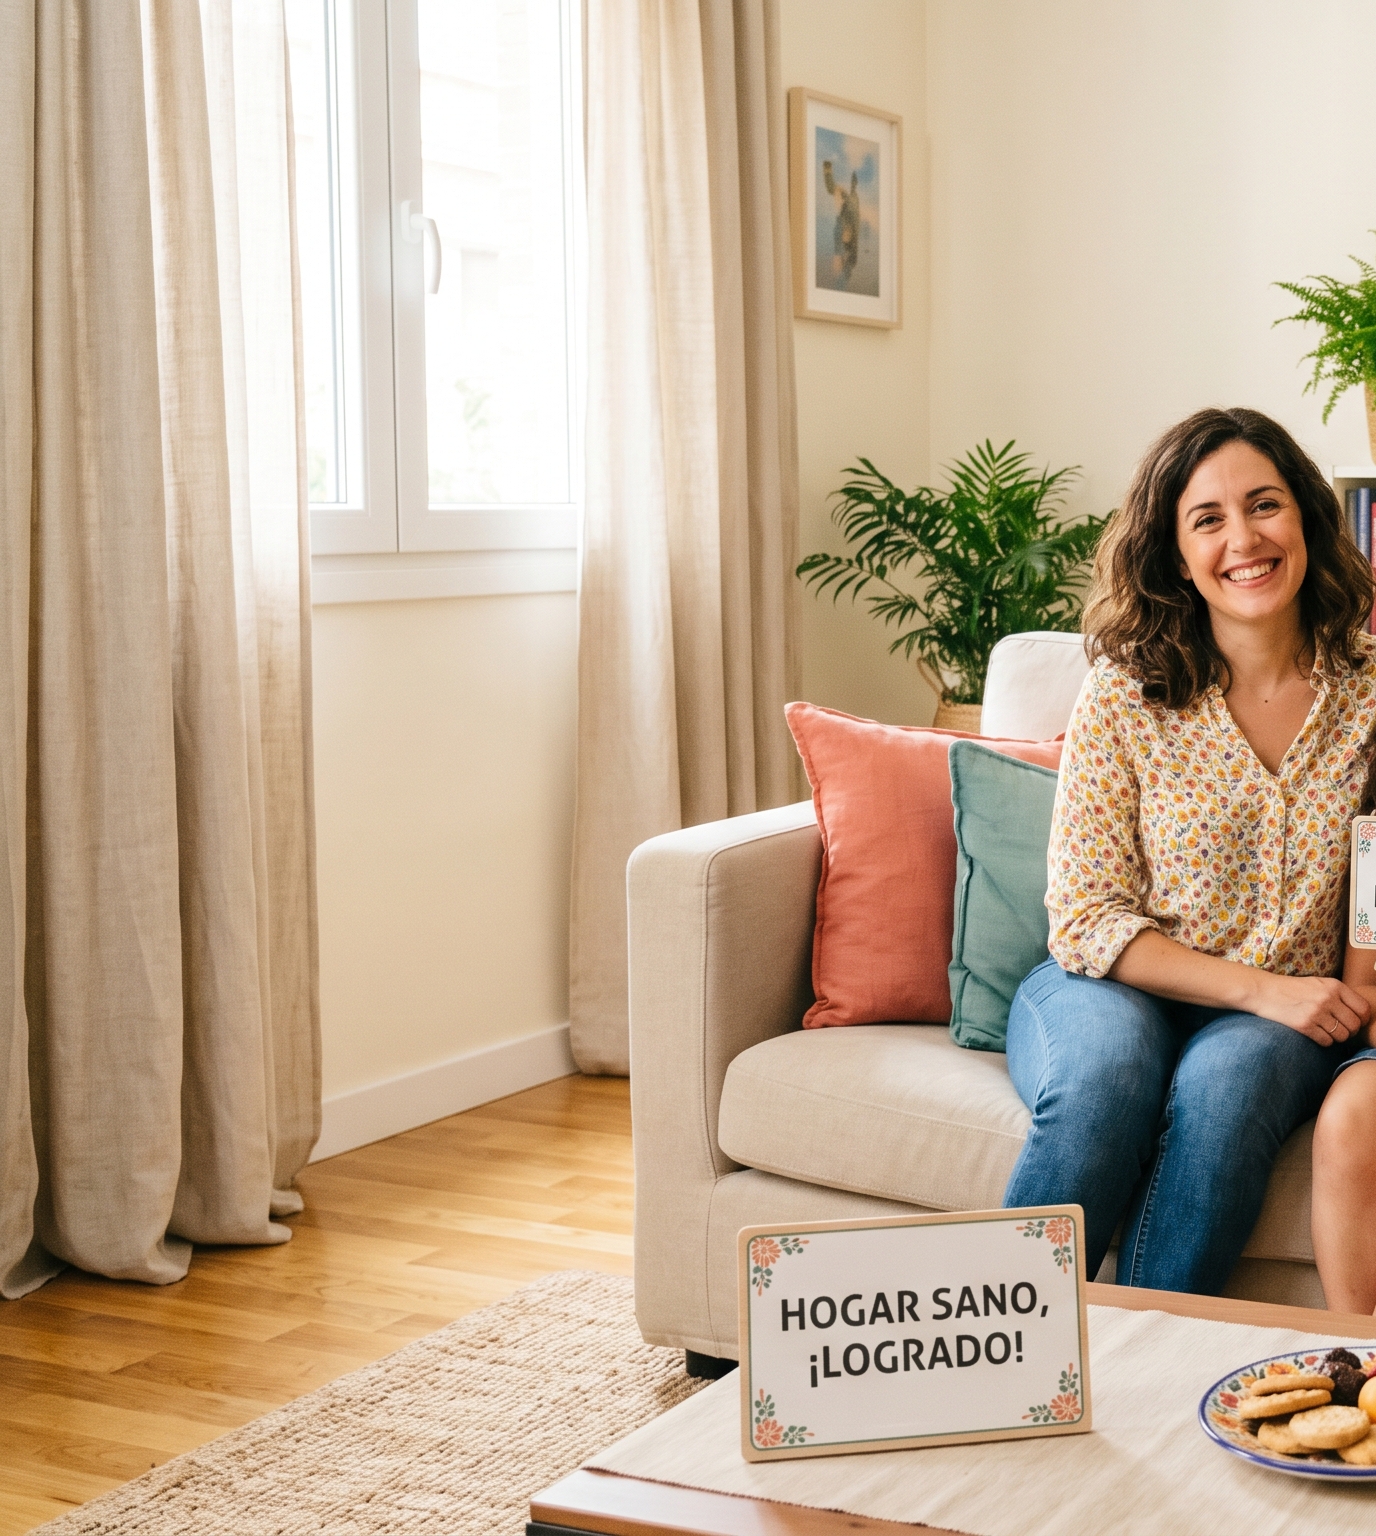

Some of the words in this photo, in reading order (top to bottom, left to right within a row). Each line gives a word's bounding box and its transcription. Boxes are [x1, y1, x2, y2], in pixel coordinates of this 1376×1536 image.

[781, 1290, 921, 1331] HOGAR
[931, 1281, 1049, 1320] SANO,
[809, 1330, 1024, 1388] ¡LOGRADO!
